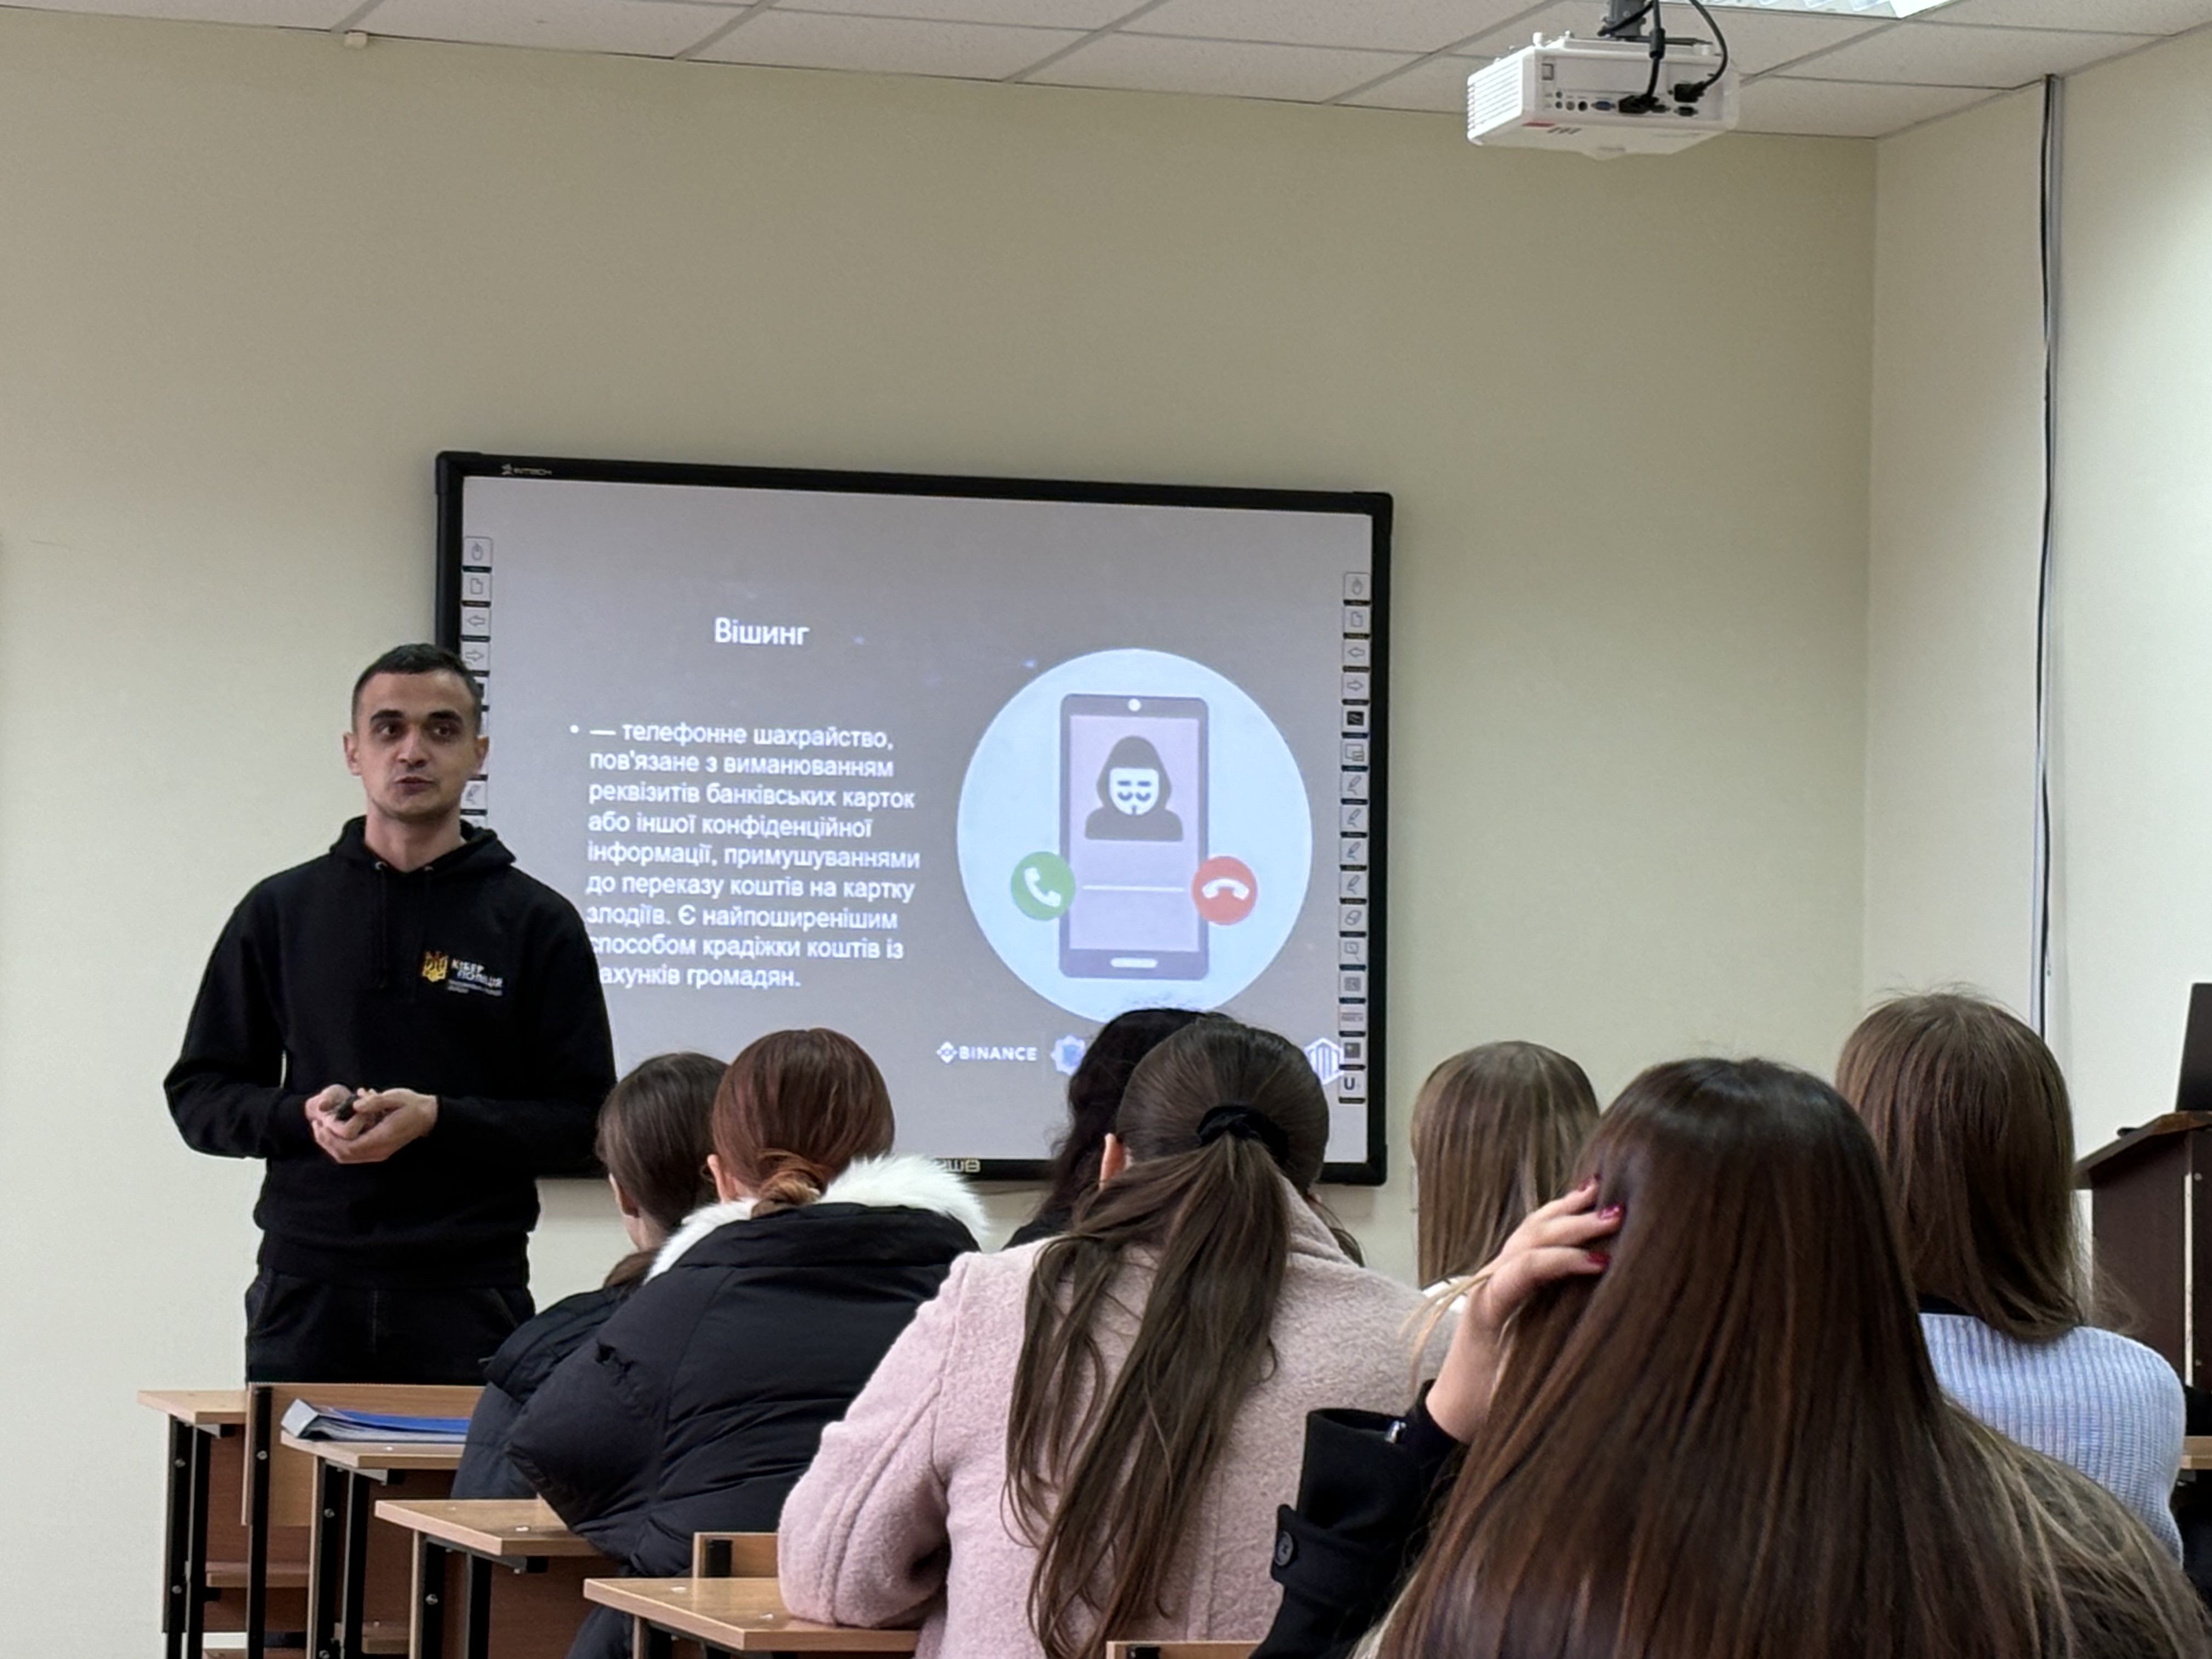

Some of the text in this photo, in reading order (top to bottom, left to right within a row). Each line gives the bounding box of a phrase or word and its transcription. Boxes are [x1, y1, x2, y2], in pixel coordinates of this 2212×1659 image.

[715, 617, 809, 645] Вішинг
[622, 722, 747, 746] телефонне
[754, 726, 893, 750] шахрайство,
[590, 750, 893, 776] пов'язане з виманюванням
[589, 781, 915, 811] реквізитів банківських карток
[588, 811, 873, 839] або іншої конфіденційної
[588, 840, 919, 870] інформації, примушуваннями
[585, 876, 915, 903] до переказу коштів на картку
[586, 904, 897, 932] злодіїв. Є найпоширенішим
[703, 936, 800, 960] крадіжки
[808, 938, 880, 958] коштів
[887, 939, 903, 958] із
[600, 963, 800, 989] ахунків громадян.
[960, 1046, 1037, 1060] BINANCE
